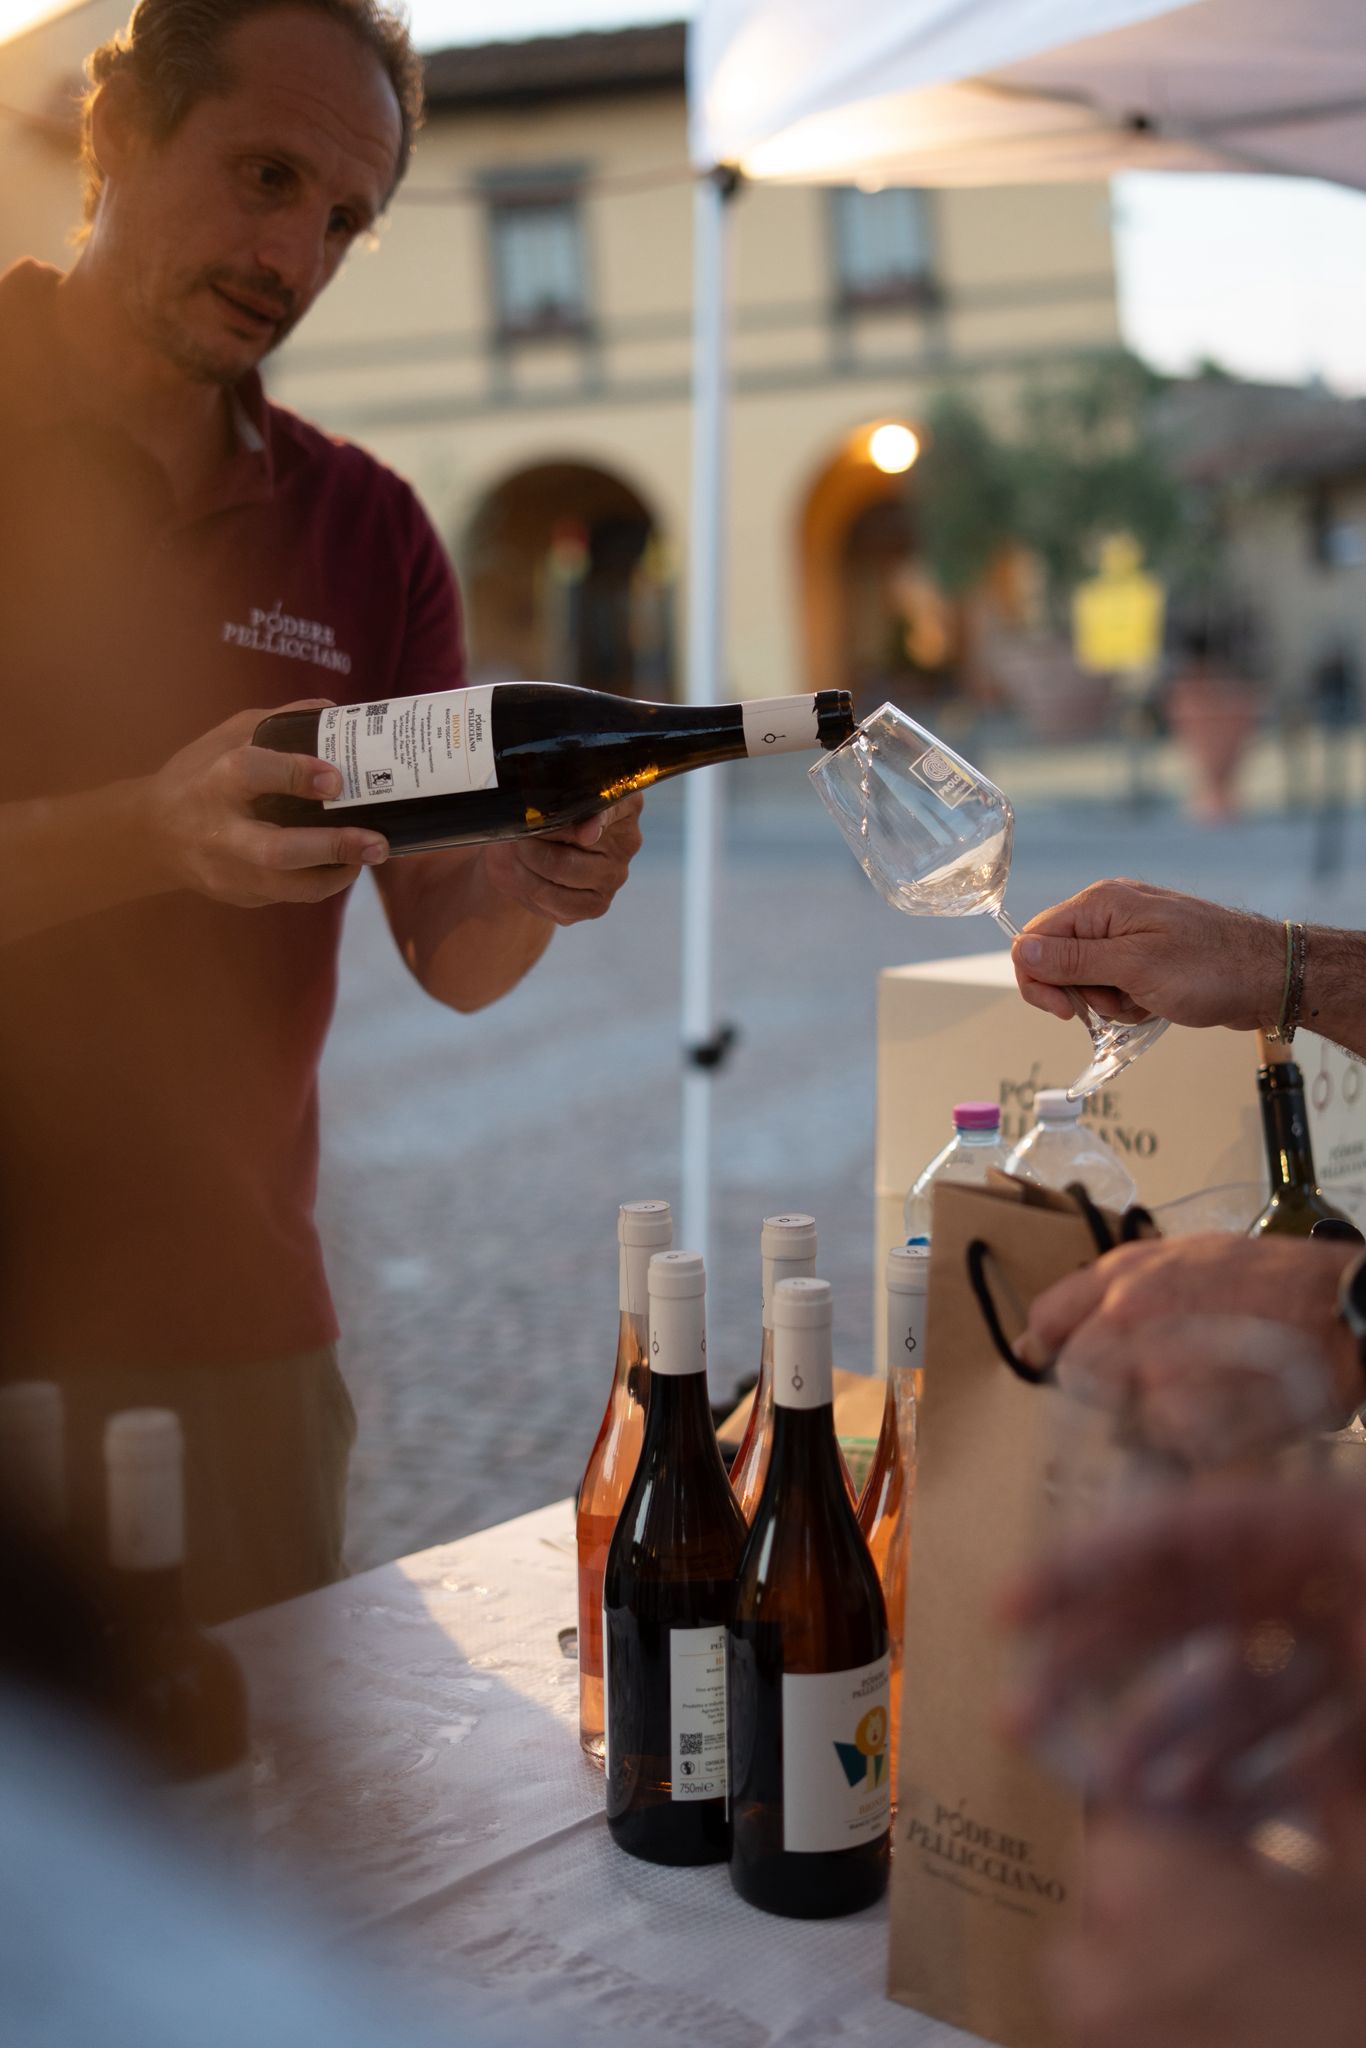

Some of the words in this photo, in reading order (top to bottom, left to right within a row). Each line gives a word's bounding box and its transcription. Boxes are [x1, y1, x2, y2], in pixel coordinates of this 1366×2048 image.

[222, 621, 352, 675] PELLICCIANO
[452, 713, 462, 749] BIONDO
[468, 708, 477, 752] PELLICCIANO
[680, 1782, 703, 1793] 750ml
[906, 1819, 1068, 1904] PELLICCIANO
